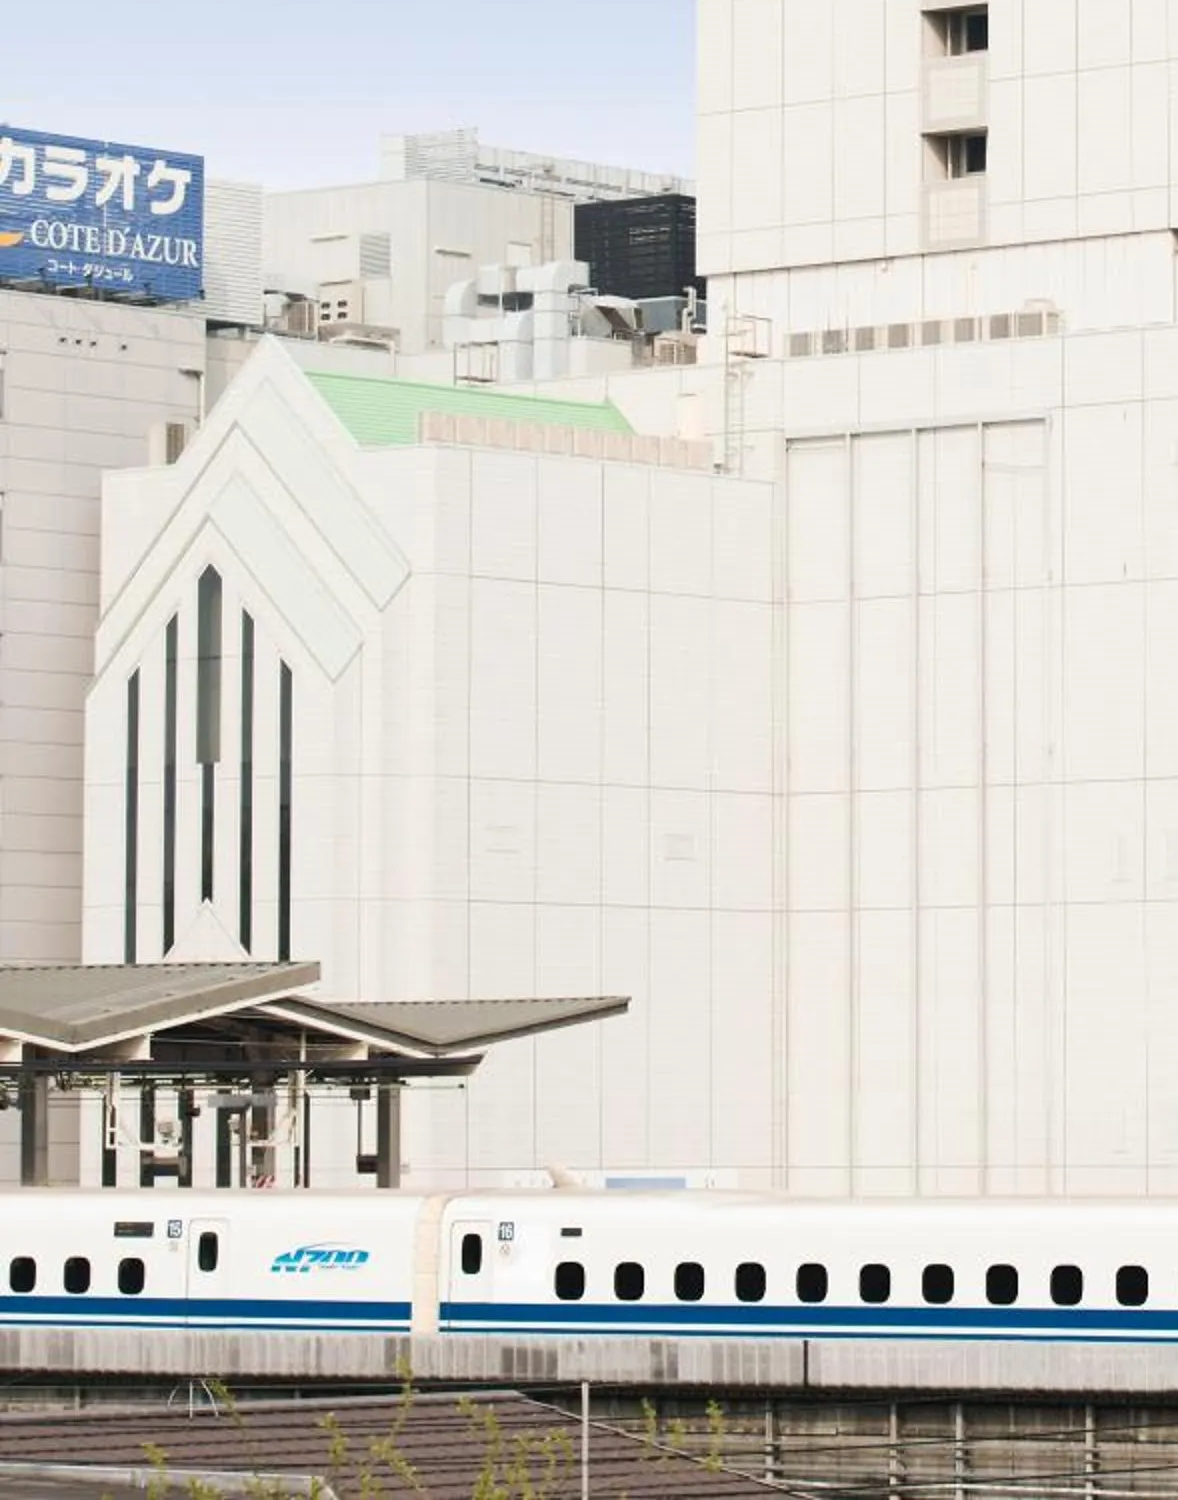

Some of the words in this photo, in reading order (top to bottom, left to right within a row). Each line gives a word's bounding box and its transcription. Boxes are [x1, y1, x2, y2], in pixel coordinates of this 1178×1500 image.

[0, 137, 192, 215] カラオケ
[500, 1224, 513, 1240] 16
